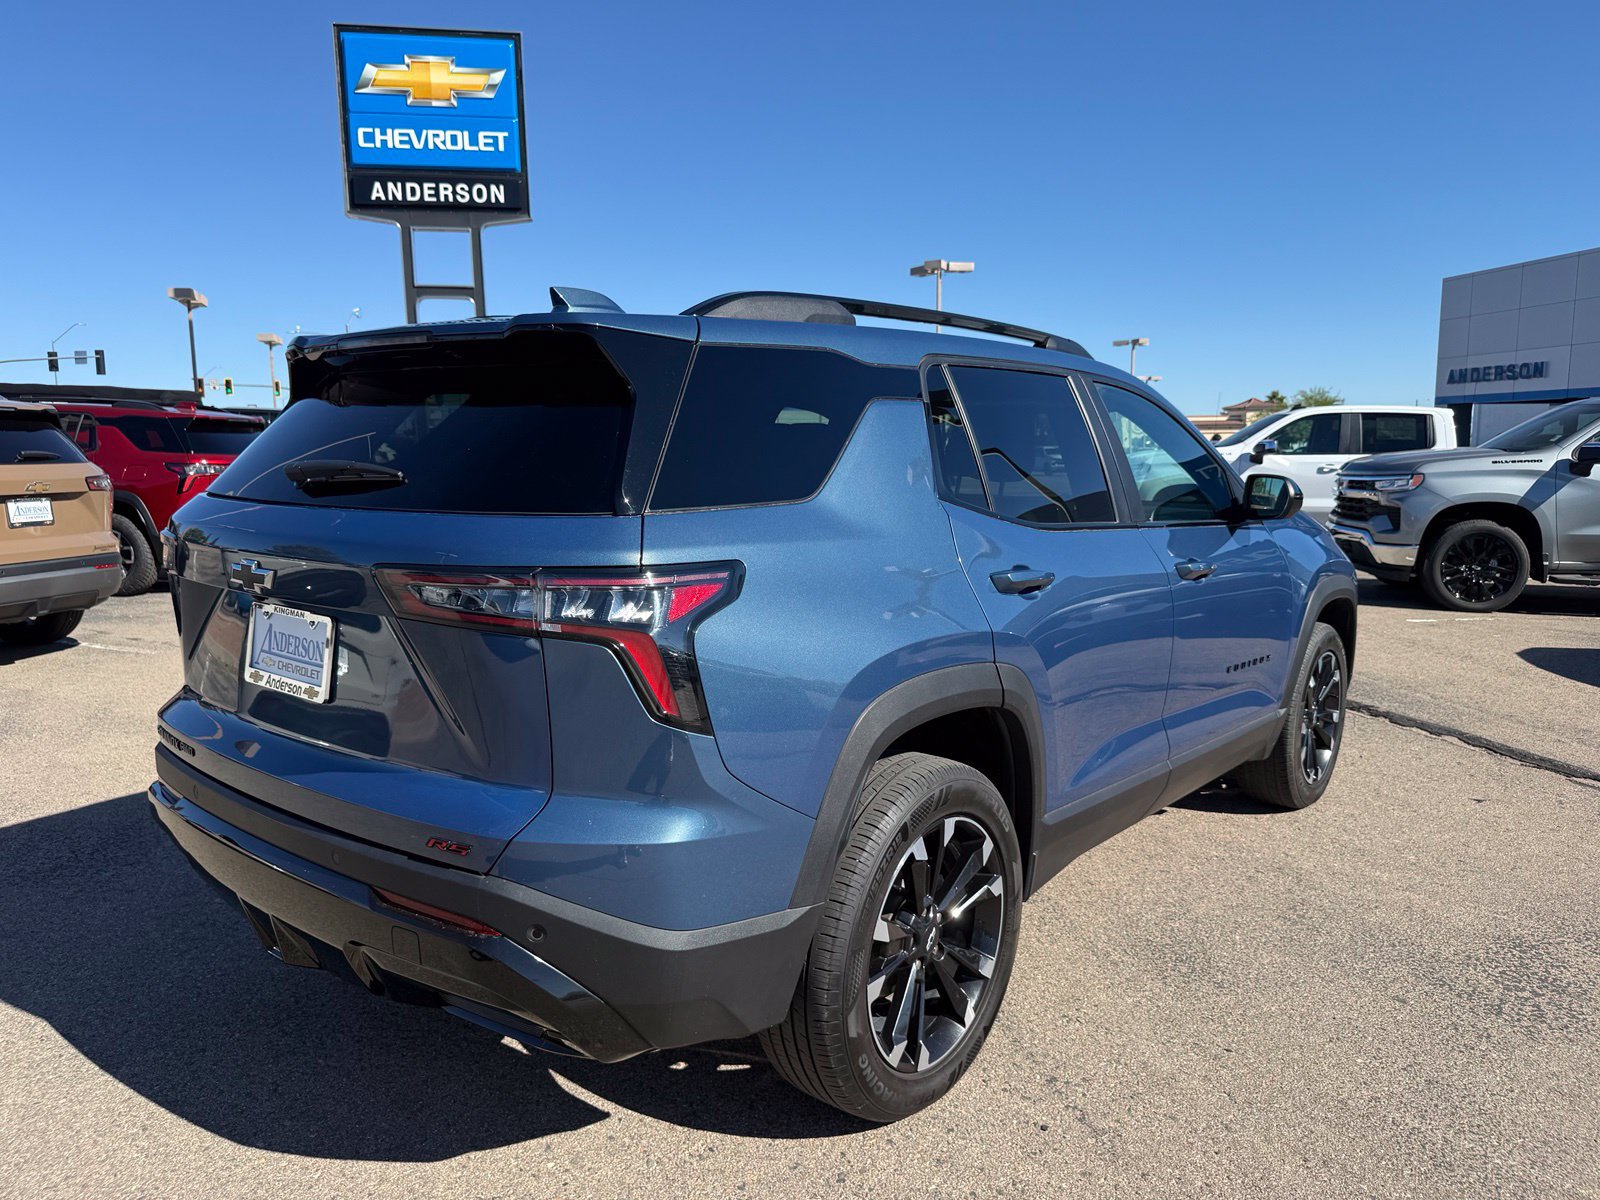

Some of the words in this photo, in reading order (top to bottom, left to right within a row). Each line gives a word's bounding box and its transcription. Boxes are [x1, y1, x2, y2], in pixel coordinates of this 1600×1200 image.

[357, 127, 509, 152] CHEVROLET
[371, 181, 506, 204] ANDERSON
[1447, 361, 1549, 384] ANDERSON
[273, 606, 305, 619] KINGMAN
[254, 623, 324, 665] ANDERSON
[276, 661, 320, 680] CHEVROLET
[265, 675, 302, 696] Anderson
[426, 837, 473, 857] RS
